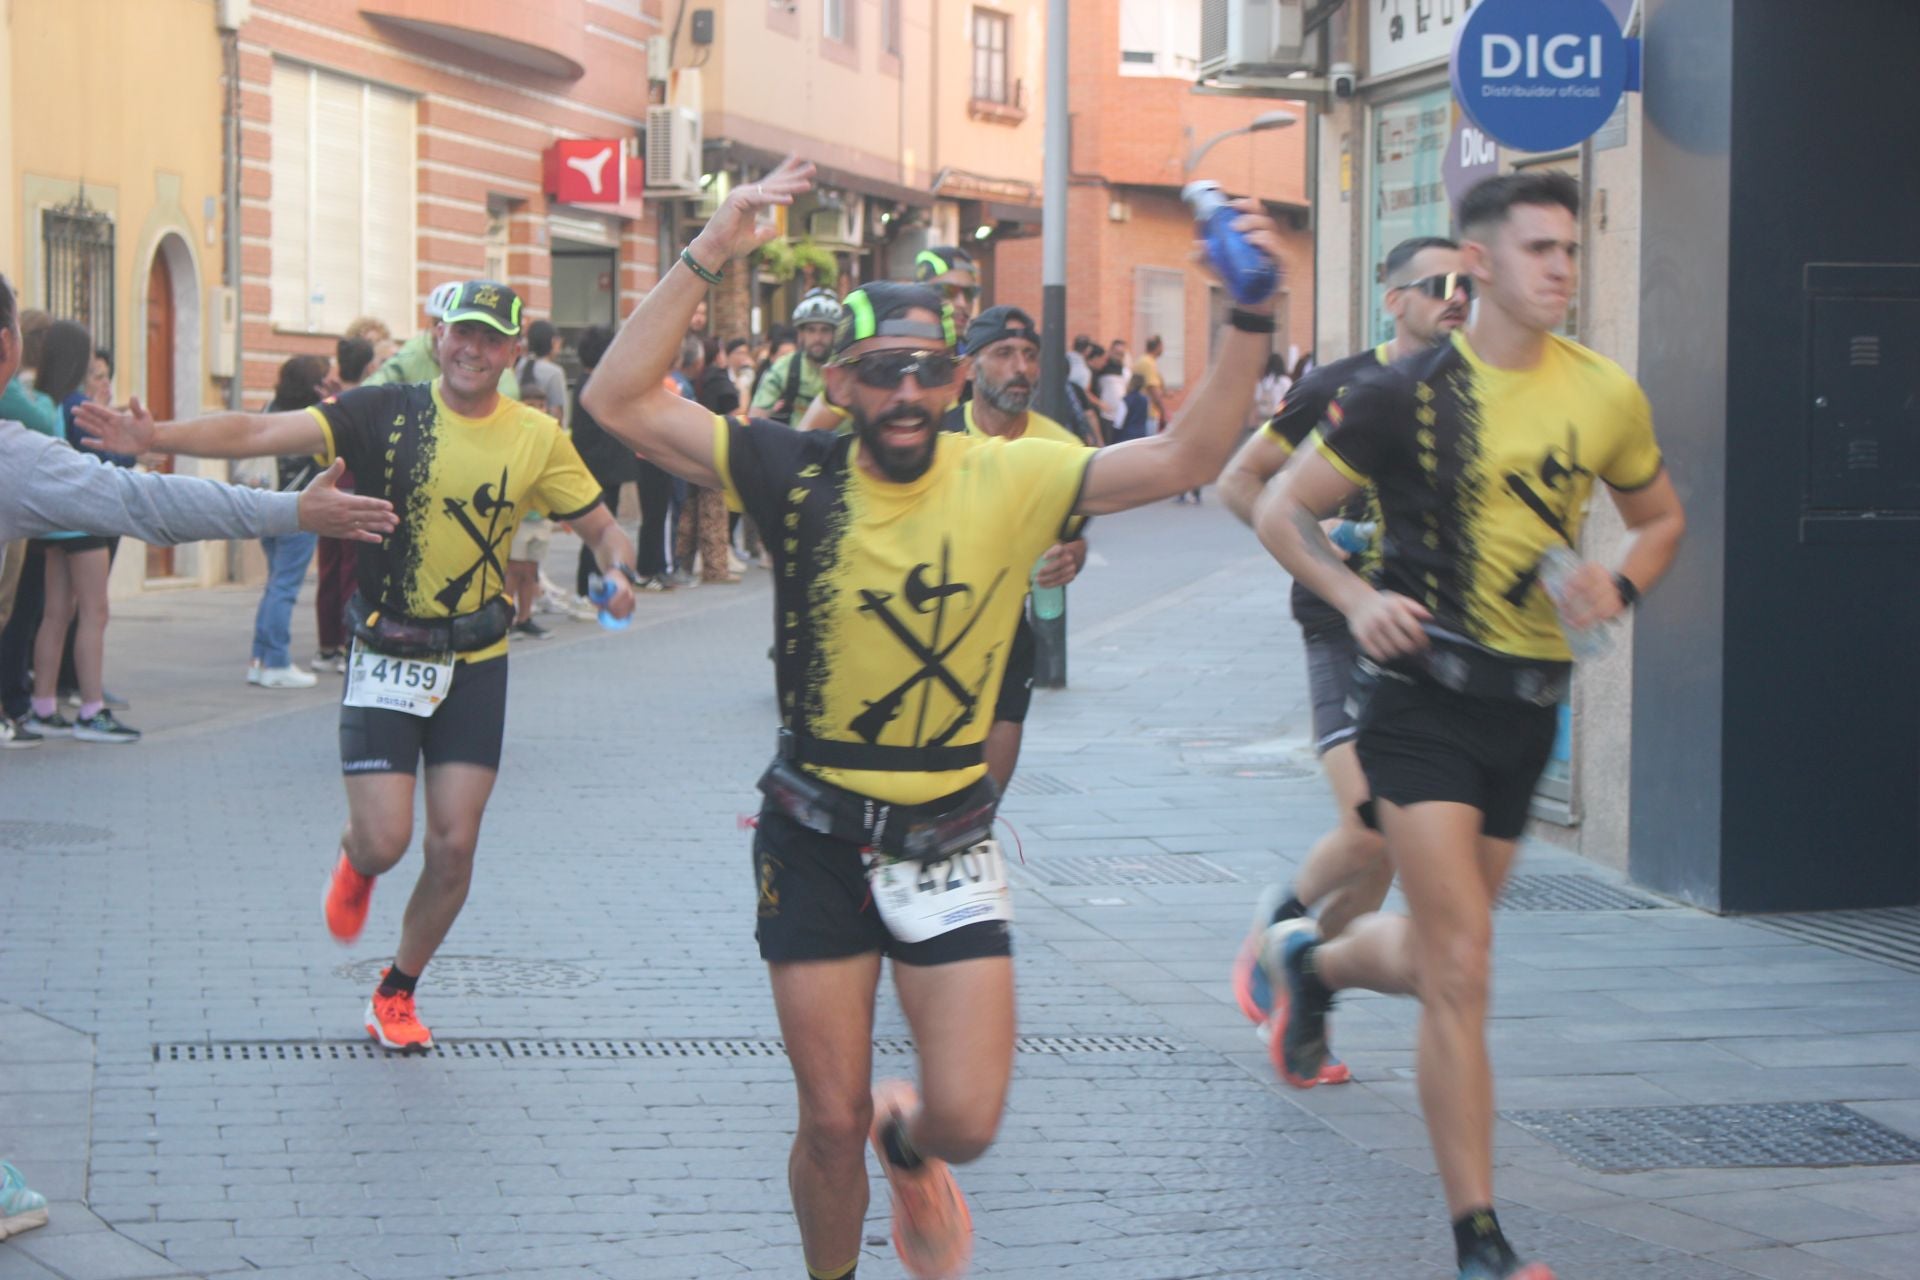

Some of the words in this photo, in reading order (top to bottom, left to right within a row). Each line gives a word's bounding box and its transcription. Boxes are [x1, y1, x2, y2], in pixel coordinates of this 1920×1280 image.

[1481, 33, 1602, 79] DIGI
[1481, 84, 1556, 98] Distribuidor
[1558, 84, 1601, 98] oficial
[371, 659, 437, 691] 4159
